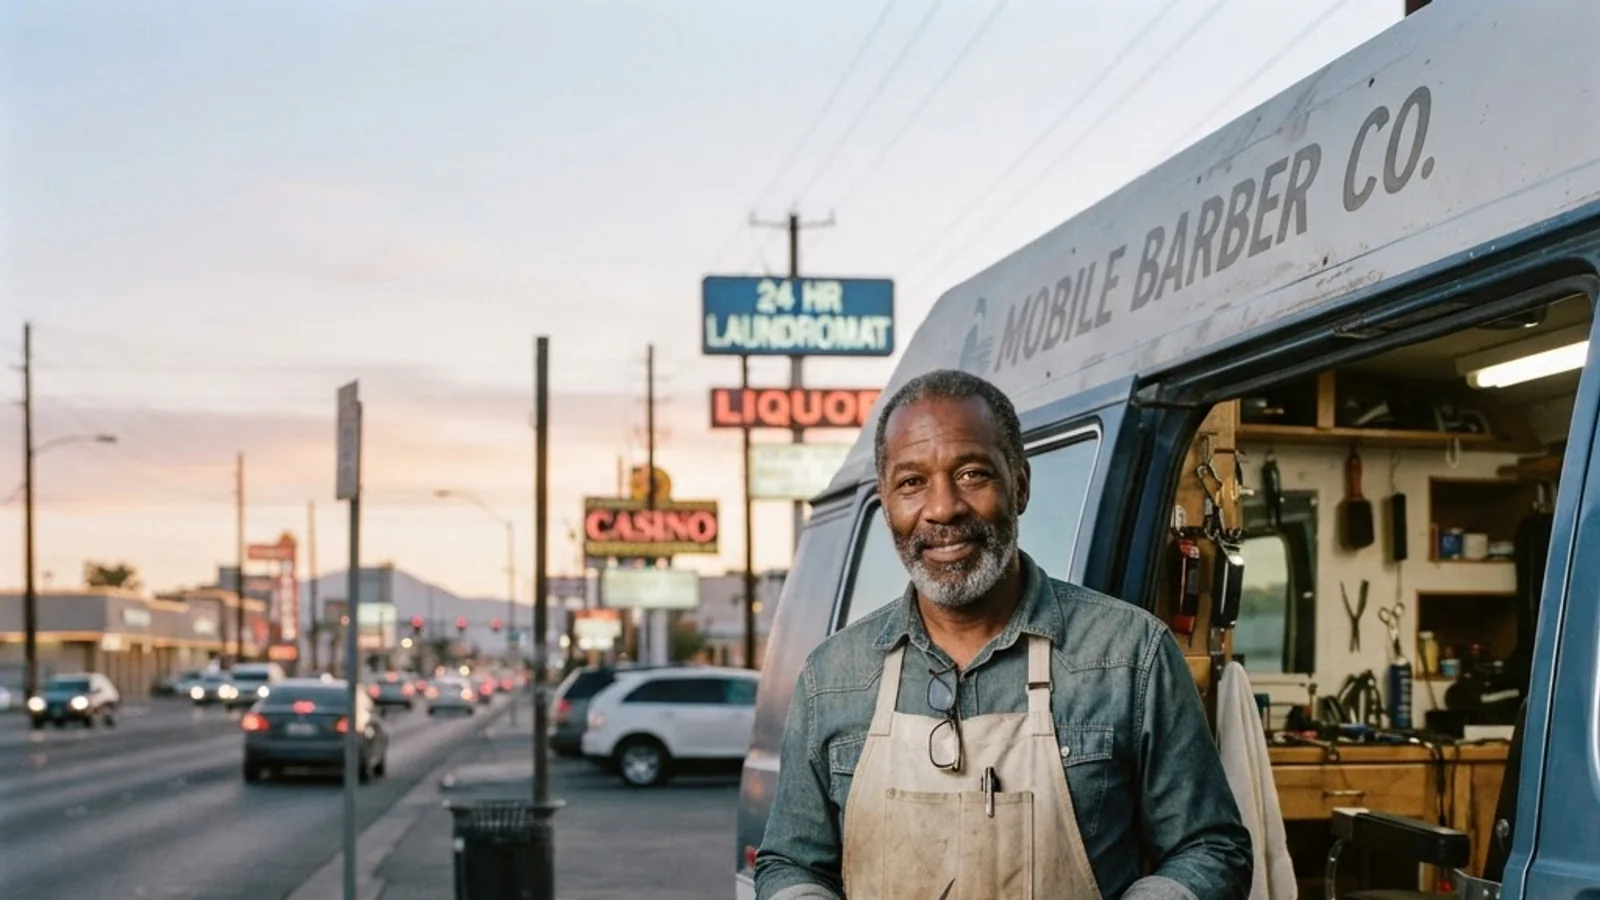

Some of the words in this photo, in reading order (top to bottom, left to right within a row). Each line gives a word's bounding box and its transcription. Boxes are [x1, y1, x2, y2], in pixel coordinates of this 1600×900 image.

[994, 245, 1126, 373] MOBILE
[1130, 142, 1321, 312] BARBER
[1343, 86, 1435, 212] CO.
[756, 279, 794, 314] 24
[802, 281, 843, 313] HR
[706, 314, 891, 350] LAUNDROMAT
[586, 509, 717, 542] CASINO
